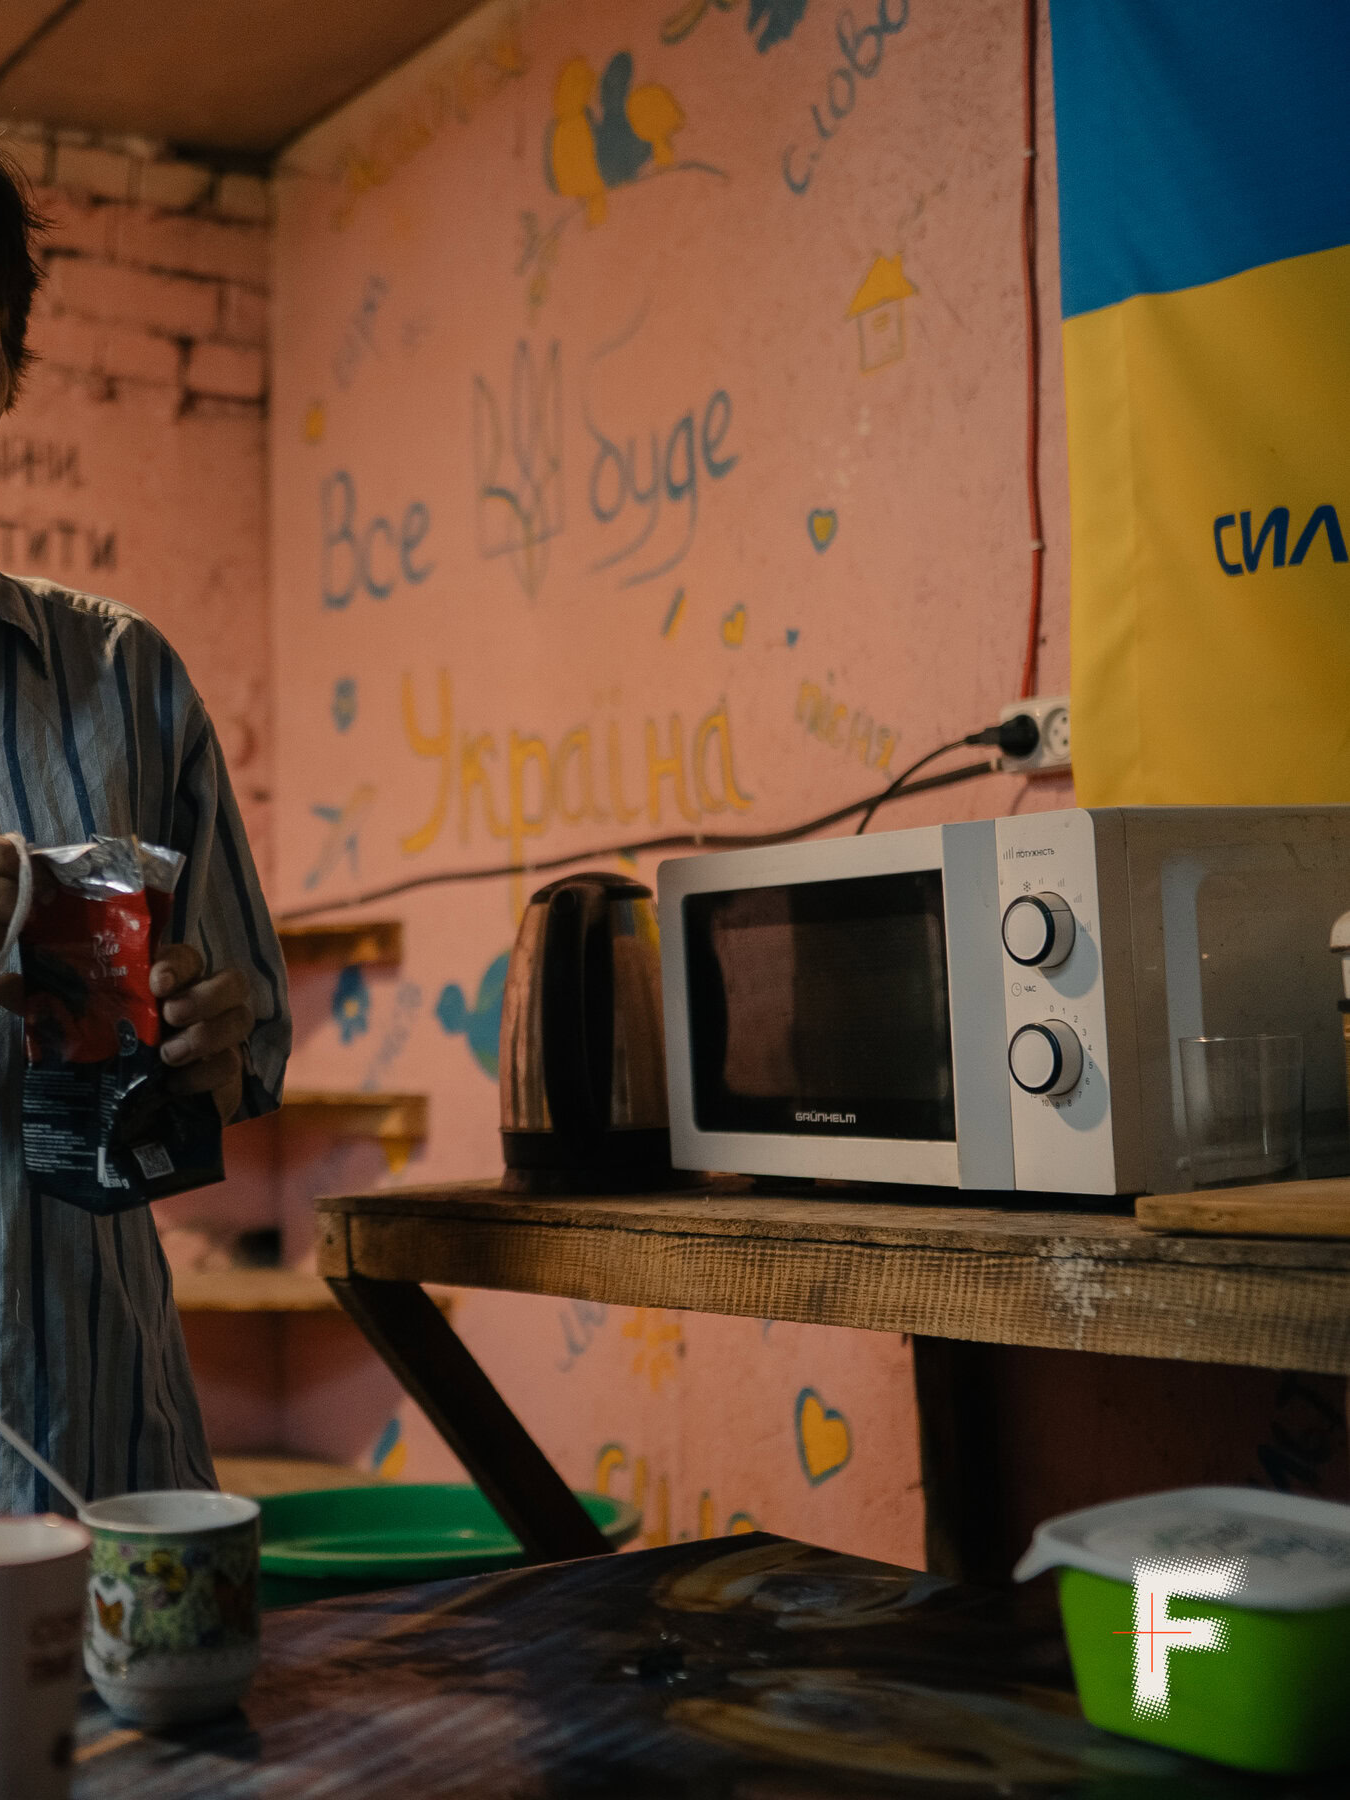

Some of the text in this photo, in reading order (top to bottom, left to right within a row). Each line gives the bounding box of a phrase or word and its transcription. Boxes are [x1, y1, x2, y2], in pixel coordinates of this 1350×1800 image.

[318, 468, 438, 611] Все
[400, 667, 754, 915] Україна
[1015, 848, 1056, 859] ПОТУЖНІСТЬ
[1024, 985, 1037, 993] ЧАС
[795, 1109, 857, 1124] GRÜNHELM
